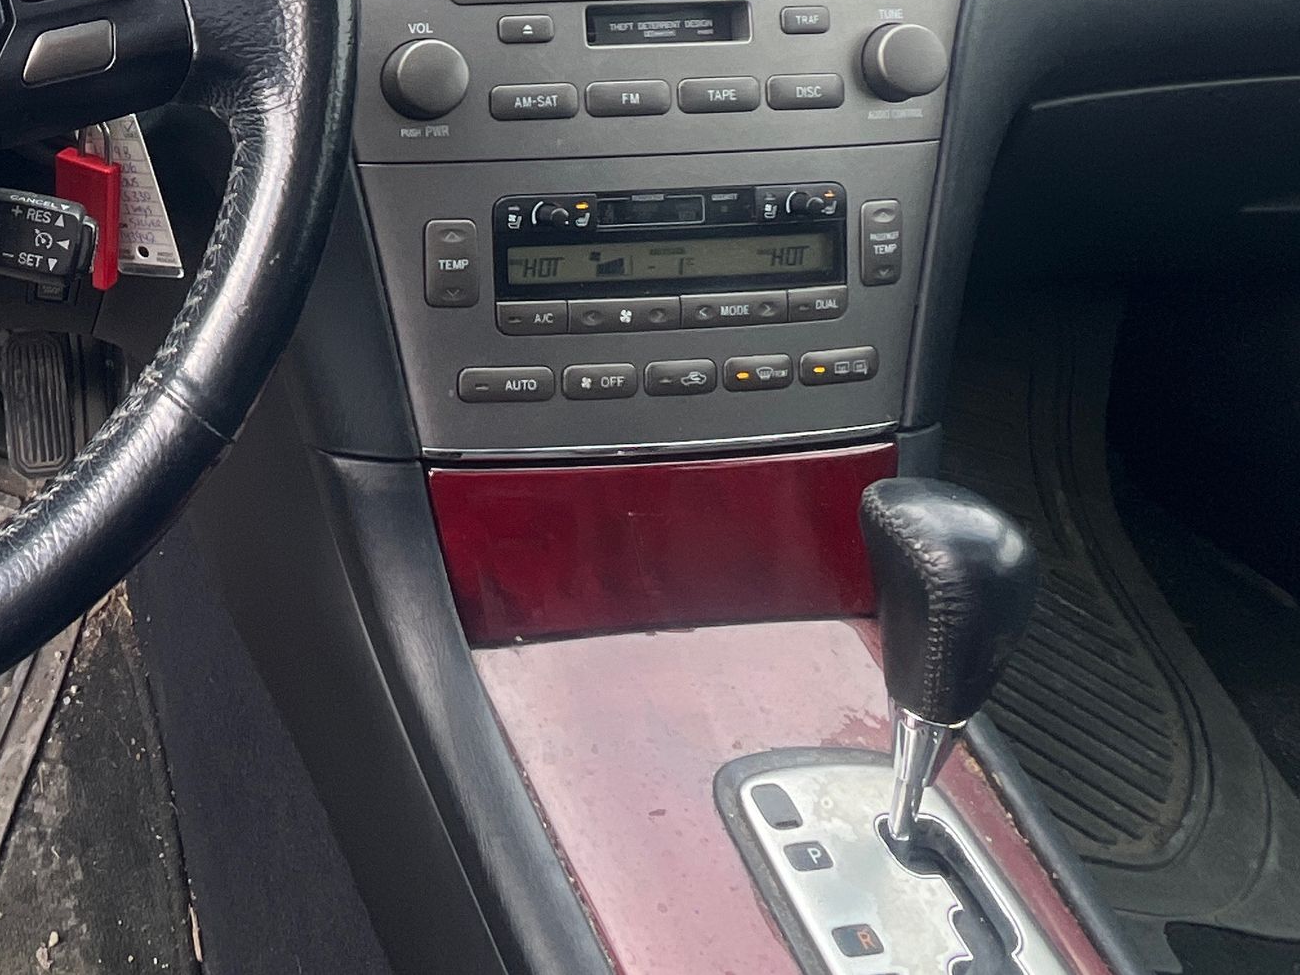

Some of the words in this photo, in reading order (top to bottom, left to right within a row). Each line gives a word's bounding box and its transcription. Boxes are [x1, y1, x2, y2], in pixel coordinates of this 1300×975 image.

[795, 15, 819, 25] TRAF
[878, 9, 903, 19] TUNE
[408, 23, 433, 34] VOL
[707, 89, 737, 101] TAPE
[796, 86, 822, 98] DISC
[514, 95, 558, 108] AM-SAT
[621, 93, 640, 105] FM
[425, 125, 449, 137] PWR
[10, 194, 58, 210] CANCEL
[26, 208, 52, 224] RES
[770, 245, 810, 266] HOT
[873, 244, 898, 256] TEMP
[18, 252, 44, 268] SET
[438, 259, 469, 271] TEMP
[523, 256, 565, 278] HOT
[816, 299, 839, 310] DUAL
[720, 305, 750, 317] MODE
[534, 313, 554, 324] A/C
[505, 379, 537, 392] AUTO
[600, 376, 625, 389] OFF
[807, 847, 822, 864] P
[856, 929, 878, 950] R
